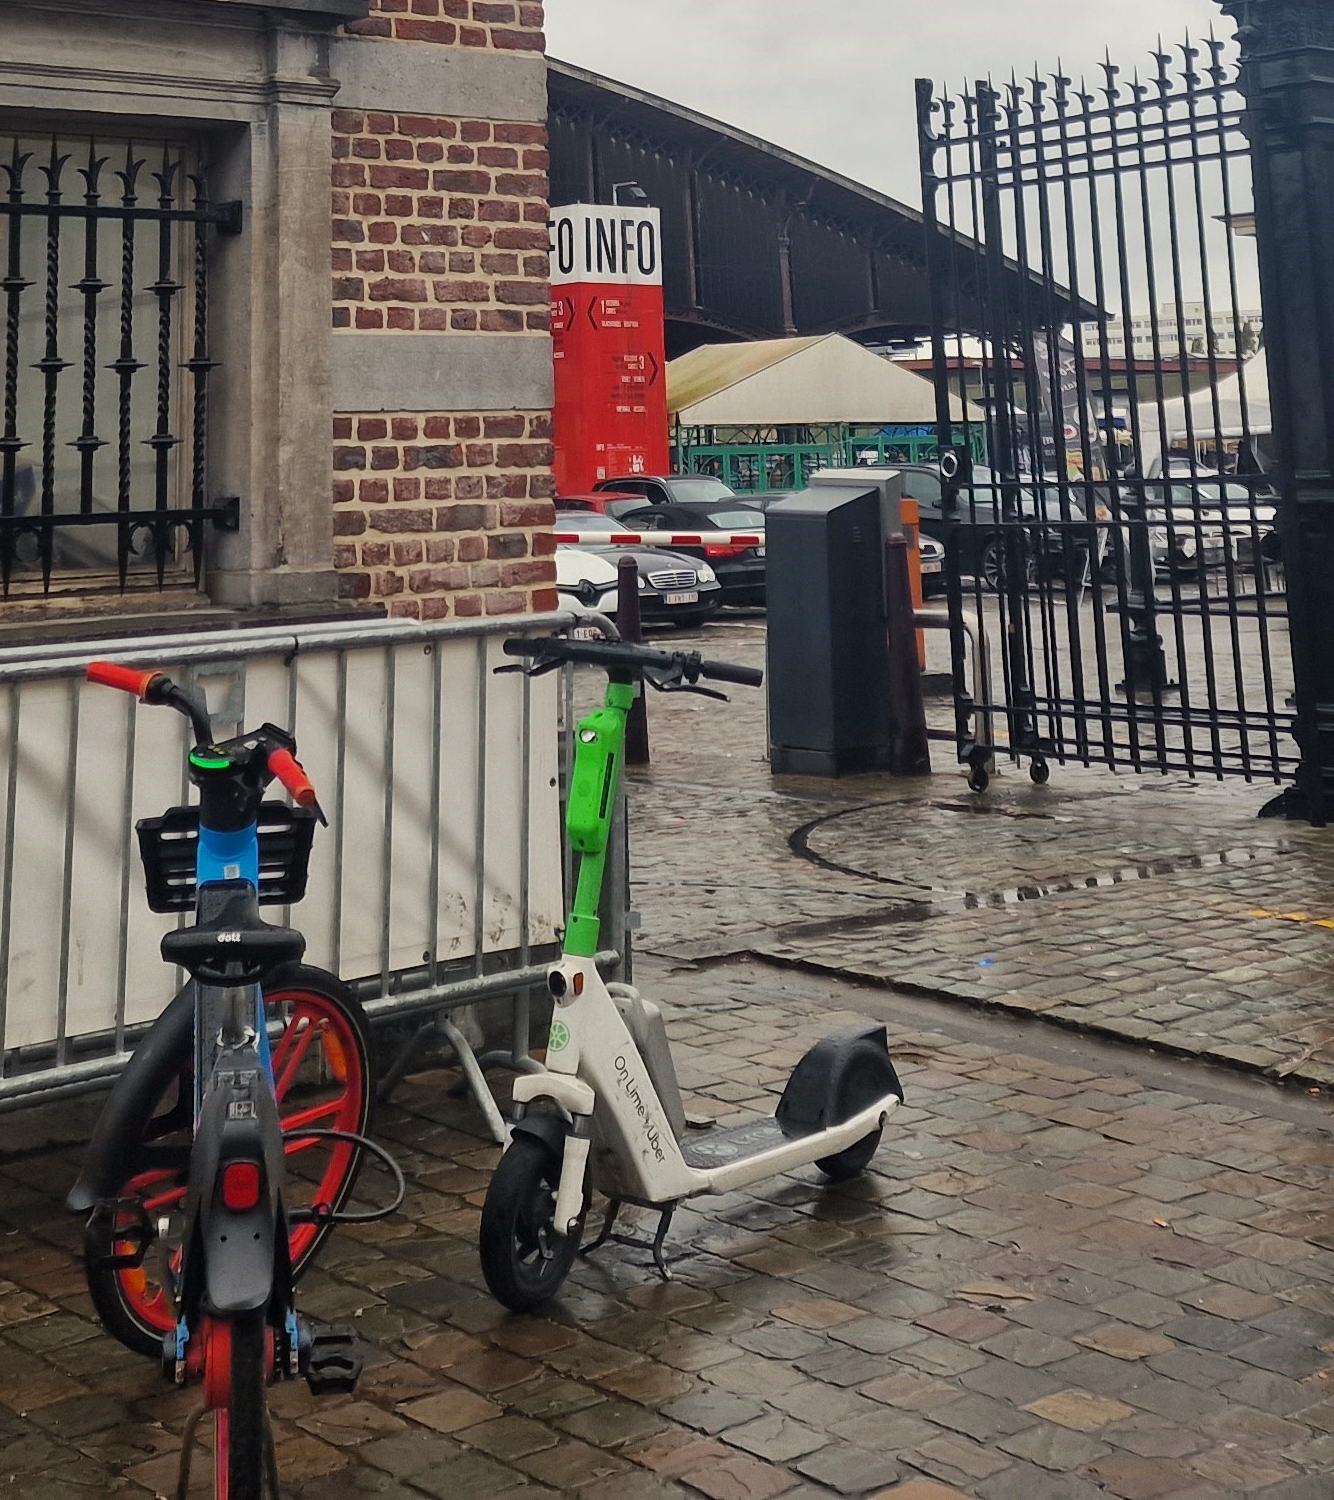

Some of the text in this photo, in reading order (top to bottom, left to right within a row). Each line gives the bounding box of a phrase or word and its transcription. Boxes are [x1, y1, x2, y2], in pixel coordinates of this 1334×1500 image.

[585, 217, 655, 275] INFO
[614, 1056, 629, 1081] On
[625, 1078, 645, 1117] Lime
[647, 1126, 666, 1164] Uber
